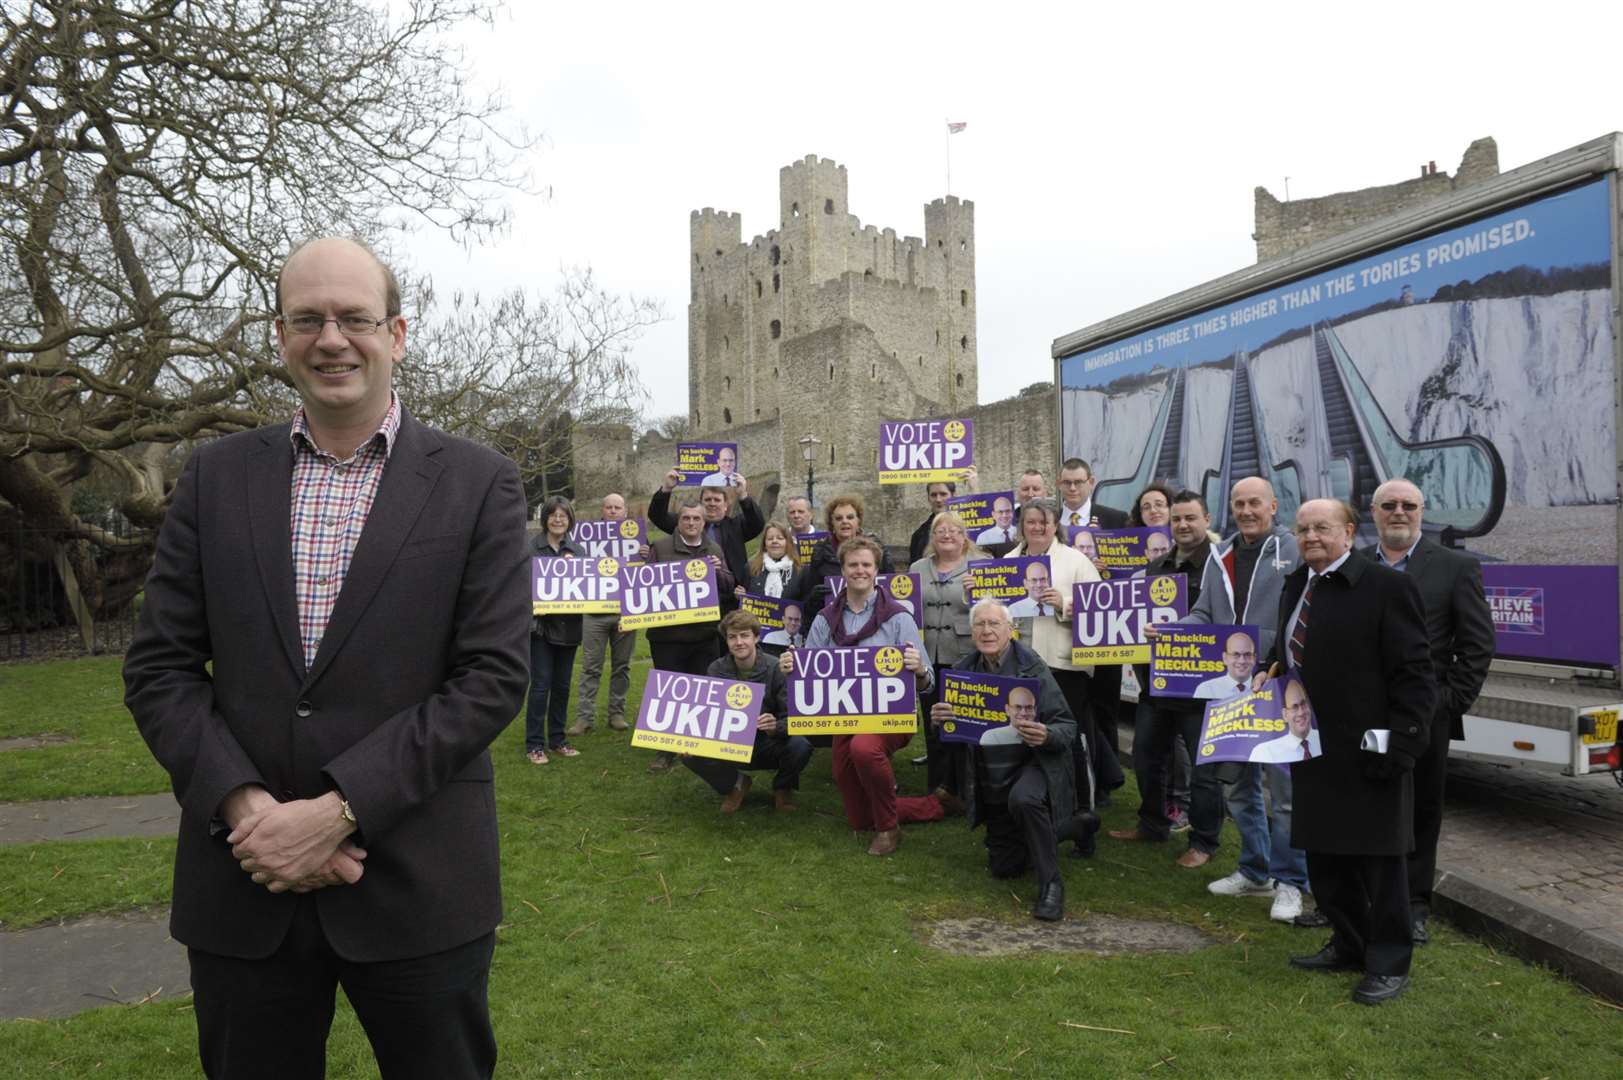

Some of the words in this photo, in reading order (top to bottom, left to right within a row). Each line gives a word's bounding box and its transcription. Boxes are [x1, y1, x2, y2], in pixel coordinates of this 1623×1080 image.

[1084, 342, 1142, 372] IMMIGRATION
[1144, 339, 1153, 353] IS
[1156, 327, 1190, 350] THREE
[1193, 314, 1227, 339] TIMES
[1231, 298, 1277, 327] HIGHER
[1281, 285, 1321, 311] THAN
[1325, 274, 1356, 298] THE
[1360, 252, 1422, 288] TORIES
[1427, 218, 1536, 268] PROMISED.
[885, 422, 941, 444] VOTE
[680, 454, 705, 463] Mark
[884, 442, 966, 470] UKIP
[569, 521, 618, 541] VOTE
[582, 539, 641, 561] KIP
[1098, 544, 1129, 556] Mark
[538, 558, 595, 577] VOTE
[623, 562, 683, 588] VOTE
[985, 566, 1018, 574] backing
[536, 577, 620, 601] UKIP
[624, 581, 710, 615] UKIP
[1078, 579, 1146, 611] VOTE
[623, 617, 641, 625] 0800
[694, 610, 718, 619] ukip.org
[1491, 611, 1534, 623] RITAIN
[1173, 633, 1216, 645] backing
[876, 656, 903, 664] UKIP
[1155, 643, 1201, 658] Mark
[794, 649, 870, 678] VOTE
[1155, 659, 1225, 672] RECKLESS
[656, 673, 724, 706] VOTE
[794, 677, 906, 715] UKIP
[945, 678, 959, 689] I'm
[961, 681, 999, 696] backing
[945, 688, 986, 708] Mark
[646, 698, 749, 741] UKIP
[843, 719, 859, 727] 587
[882, 718, 913, 727] ukip.org
[952, 705, 1008, 723] ECKLESS
[1208, 703, 1256, 729] Mark
[1205, 717, 1286, 740] RECKLESS
[637, 734, 658, 742] 0800
[660, 736, 674, 745] 587
[684, 740, 699, 749] 587
[720, 747, 748, 757] ukip.org
